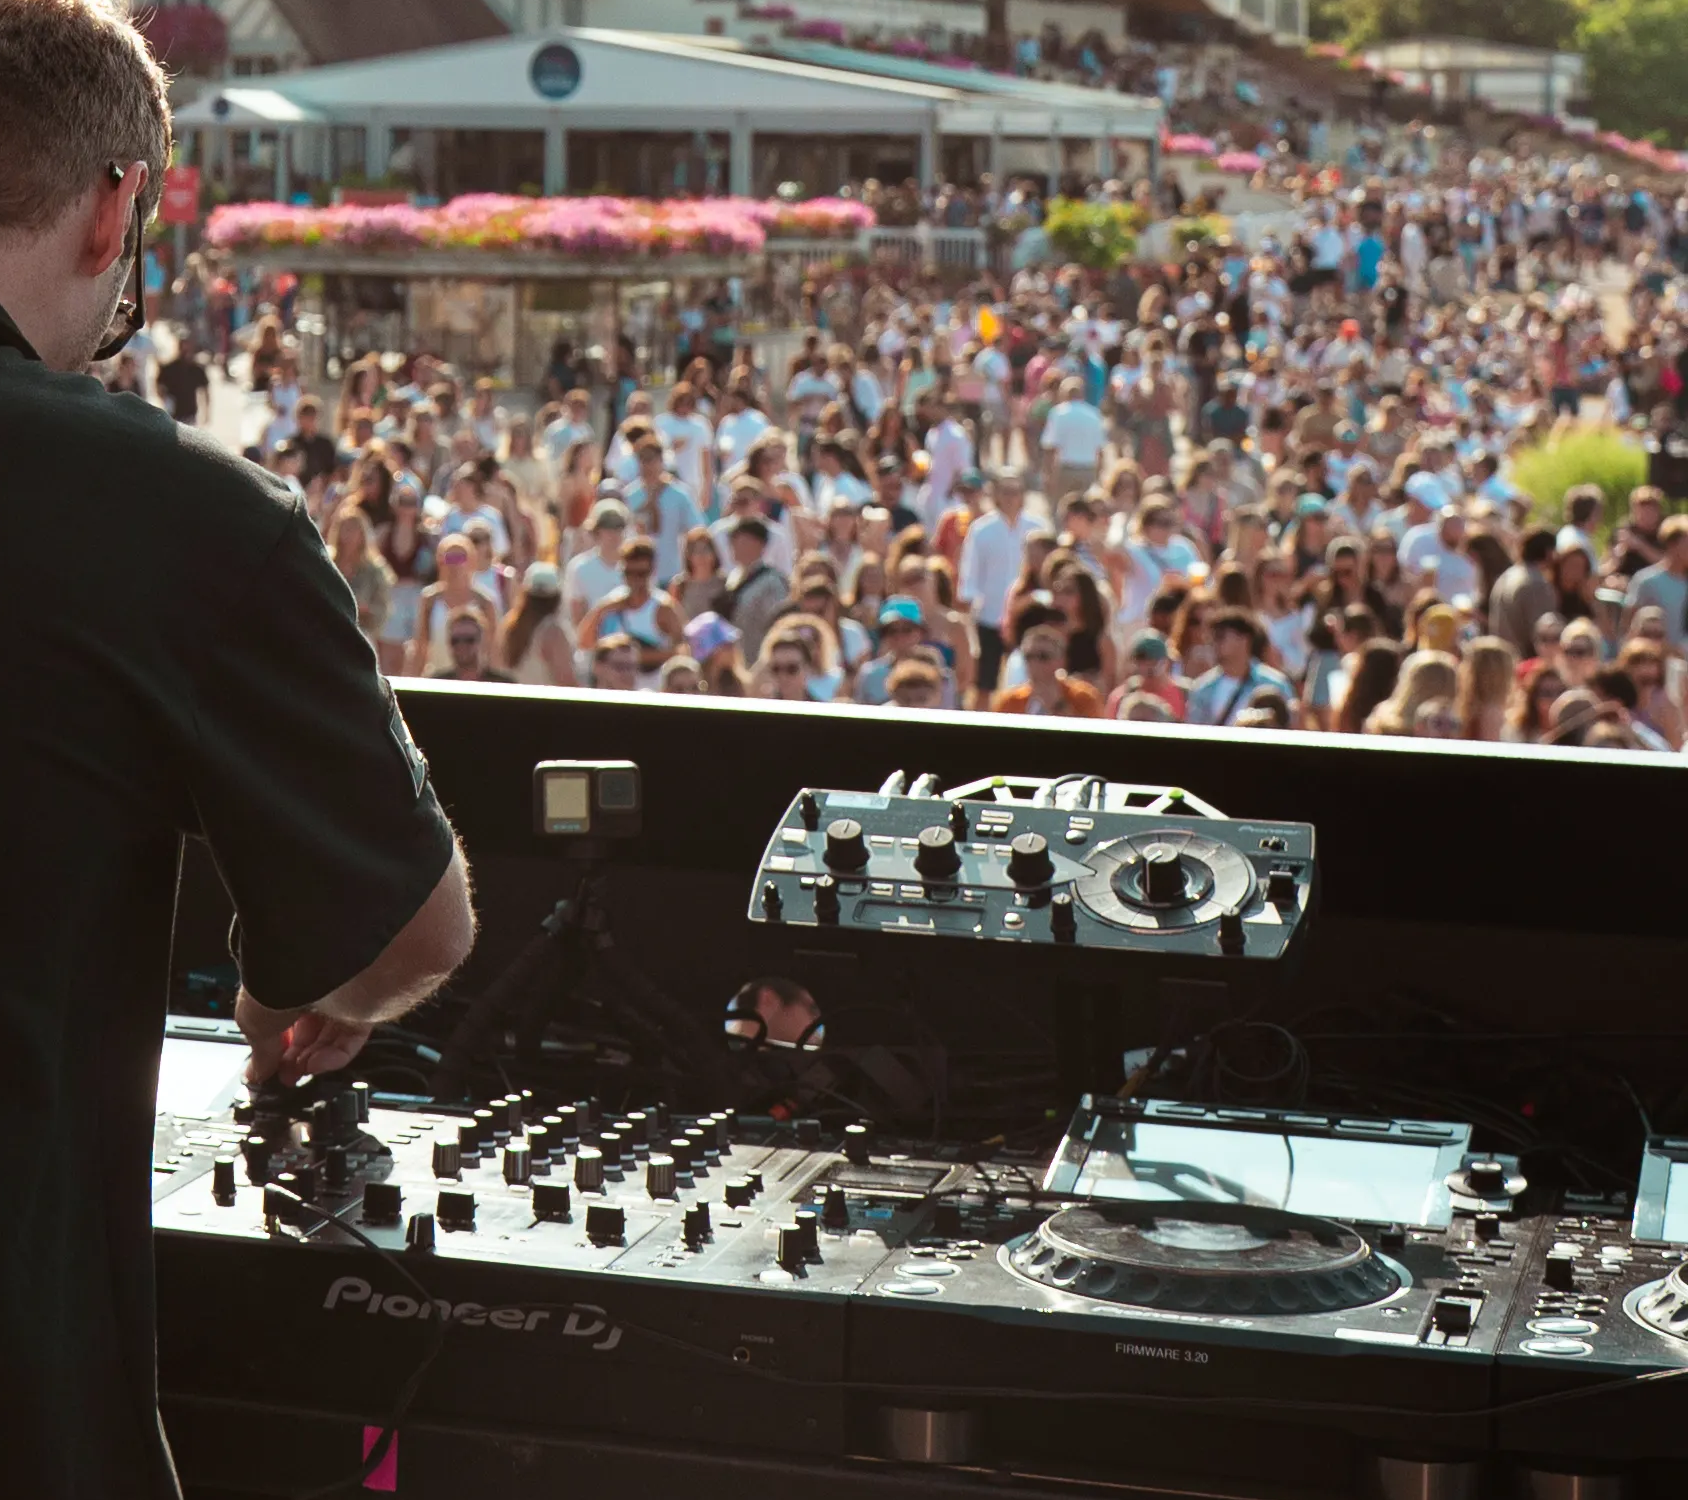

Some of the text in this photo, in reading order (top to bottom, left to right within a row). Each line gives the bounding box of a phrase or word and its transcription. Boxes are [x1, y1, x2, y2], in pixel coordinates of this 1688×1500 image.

[322, 1275, 550, 1332] Pioneer
[1115, 1342, 1209, 1364] FIRMWARE 3.20
